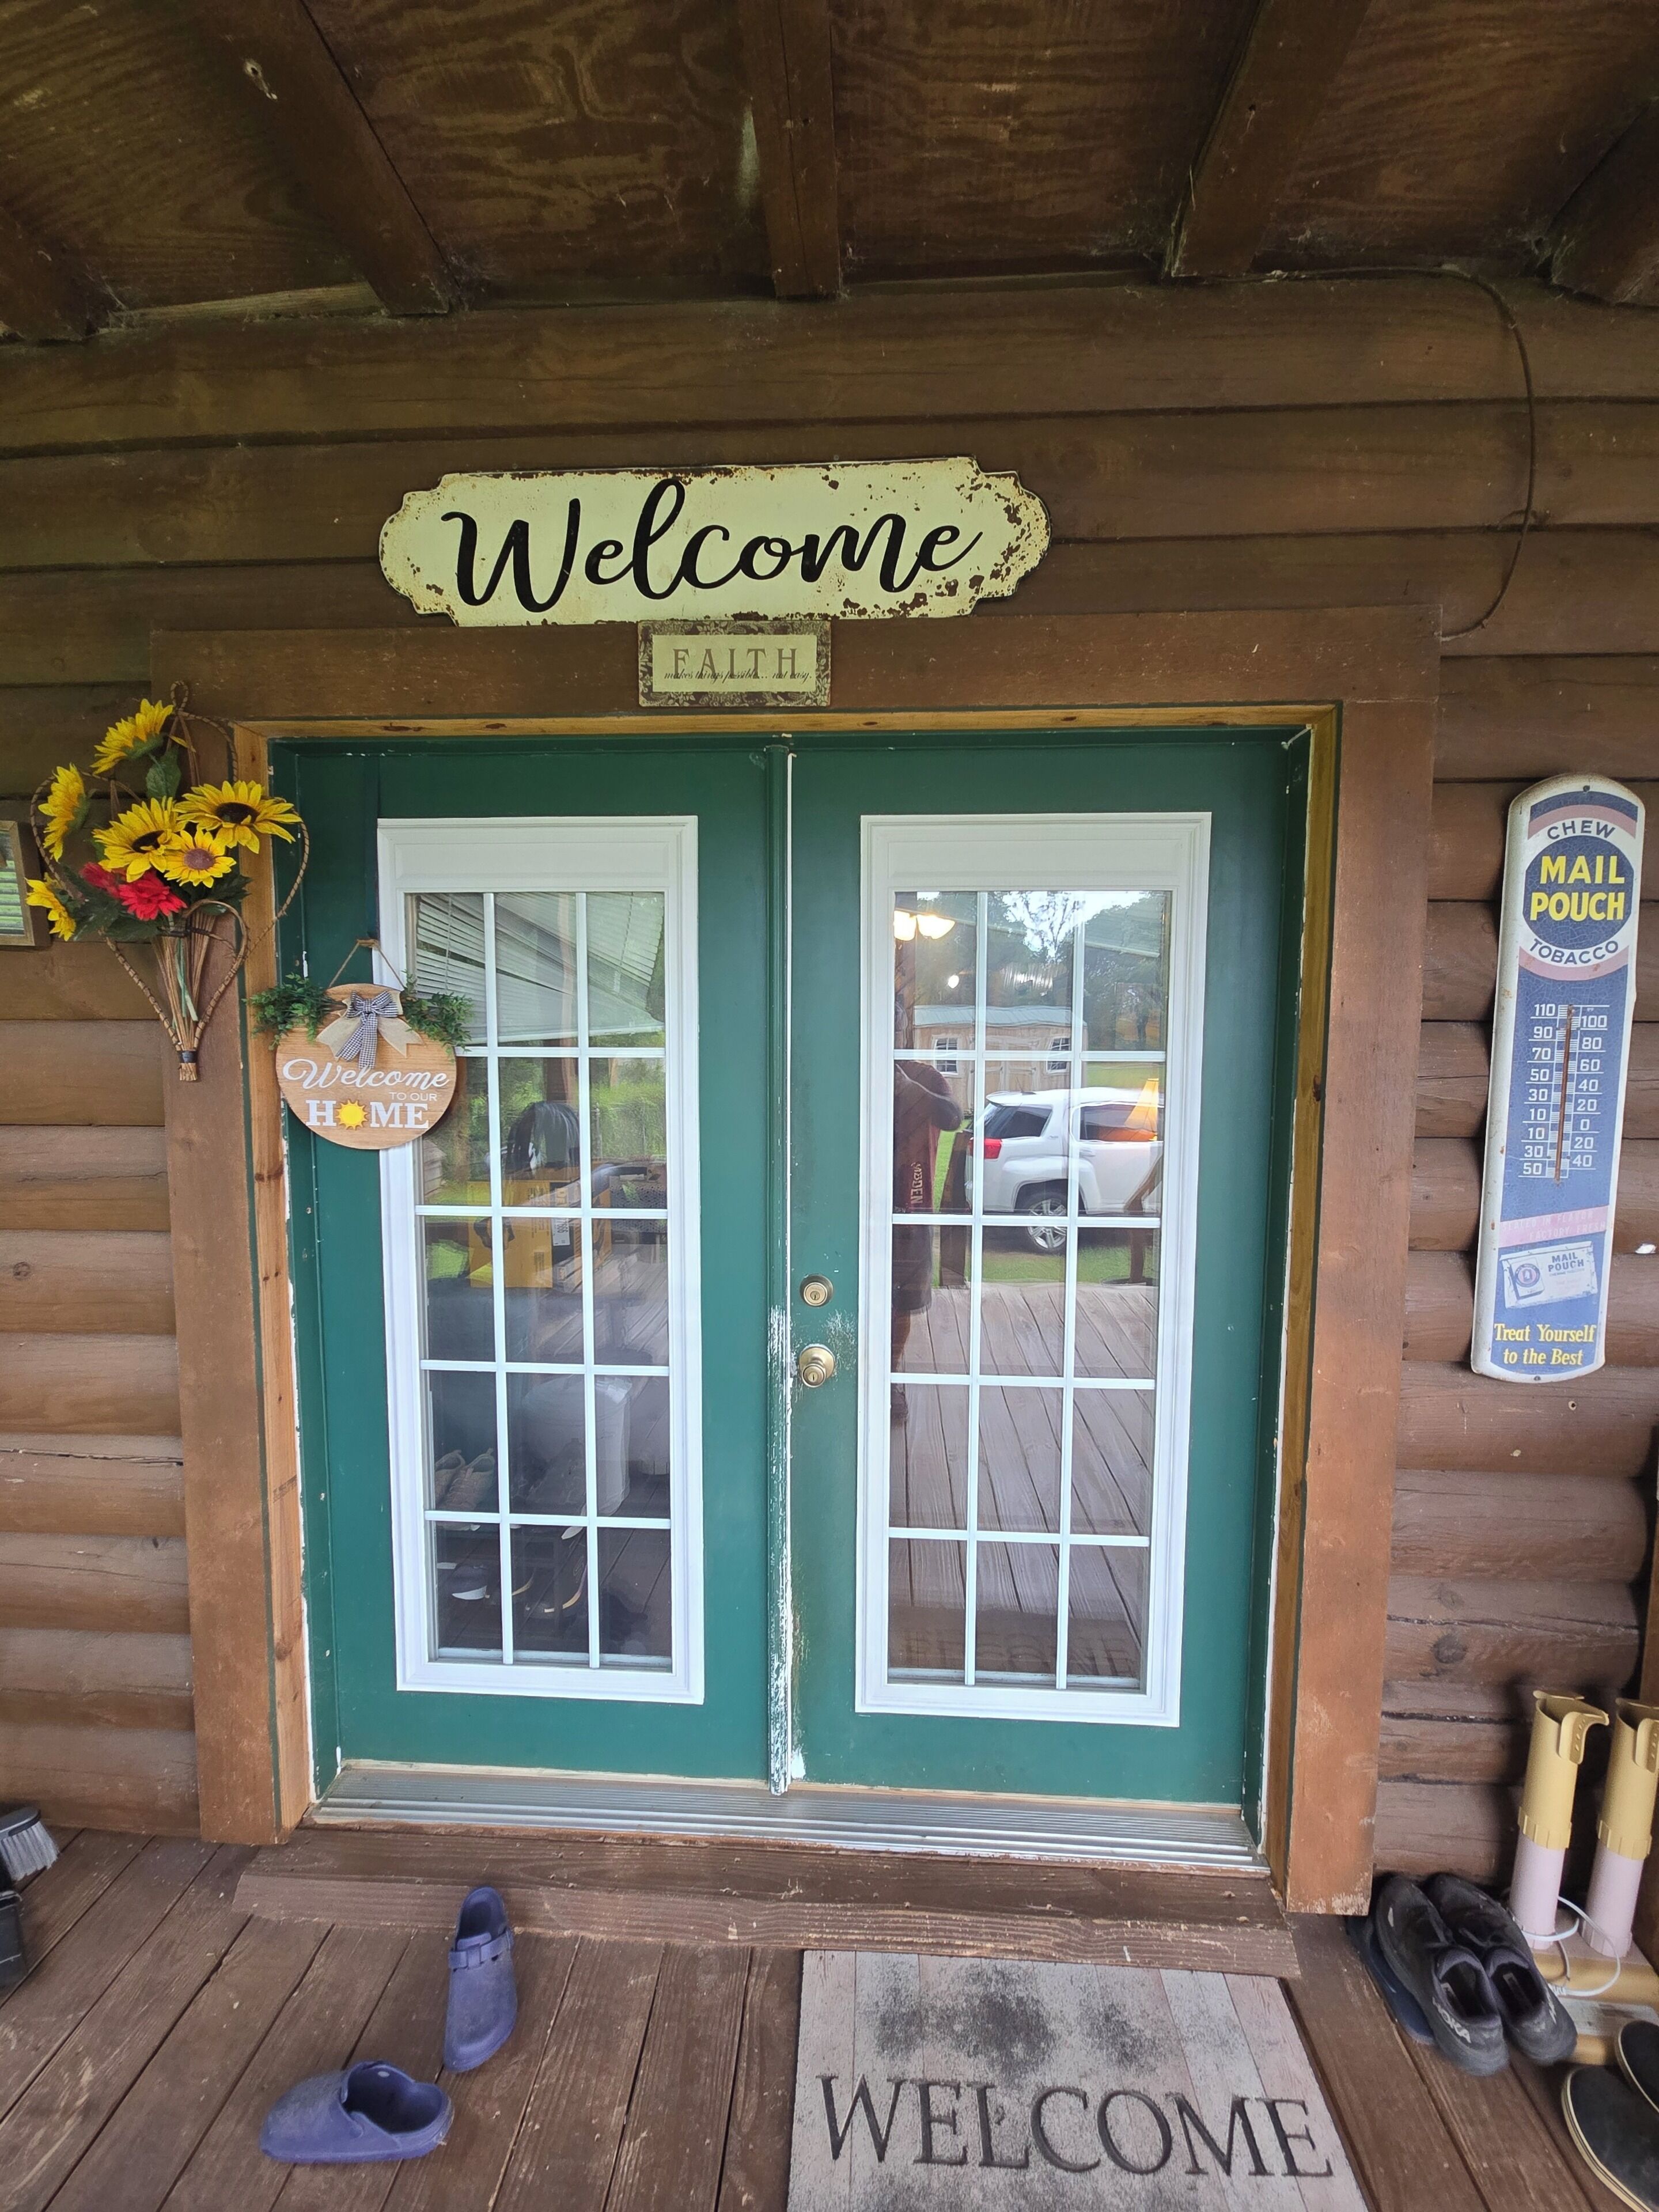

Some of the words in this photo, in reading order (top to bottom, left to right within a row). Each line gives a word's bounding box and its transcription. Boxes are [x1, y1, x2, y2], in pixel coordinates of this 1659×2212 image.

[441, 478, 984, 612] Welcome
[672, 648, 797, 679] FAITH
[664, 668, 693, 679] makes
[695, 668, 723, 684] things
[772, 670, 788, 679] not
[1547, 820, 1615, 840] CHEW
[1540, 855, 1625, 884] MAIL
[1530, 892, 1625, 921] POUCH
[1529, 939, 1619, 965] TOBACCO
[1534, 1003, 1555, 1016] 110
[1582, 1015, 1607, 1028] 100
[1533, 1026, 1552, 1039] 90
[1582, 1037, 1602, 1050] 80
[1532, 1047, 1551, 1060] 70
[1580, 1059, 1600, 1071] 60
[282, 1058, 449, 1090] Welcome
[1530, 1069, 1550, 1081] 50
[1578, 1079, 1599, 1092] 40
[389, 1092, 407, 1101] TO
[410, 1092, 438, 1101] OUR
[1528, 1089, 1548, 1101] 30
[1577, 1099, 1597, 1111] 20
[1529, 1108, 1546, 1120] 10
[1580, 1119, 1590, 1131] 0
[1528, 1127, 1545, 1139] 10
[1574, 1137, 1594, 1149] 20
[1524, 1145, 1543, 1157] 30
[1572, 1154, 1592, 1167] 40
[1522, 1162, 1542, 1175] 50
[1543, 1215, 1551, 1225] IN
[1557, 1211, 1594, 1222] FLAVOR
[1529, 1227, 1570, 1239] FACTORY
[1577, 1221, 1605, 1233] FRESH
[1551, 1252, 1578, 1263] MAIL
[1548, 1259, 1584, 1272] POUCH
[1494, 1323, 1531, 1341] Treat
[1536, 1324, 1596, 1342] Yourself
[1503, 1348, 1518, 1364] to
[1523, 1348, 1546, 1364] the
[1550, 1348, 1584, 1365] Best
[815, 2073, 1334, 2177] WELCOME
